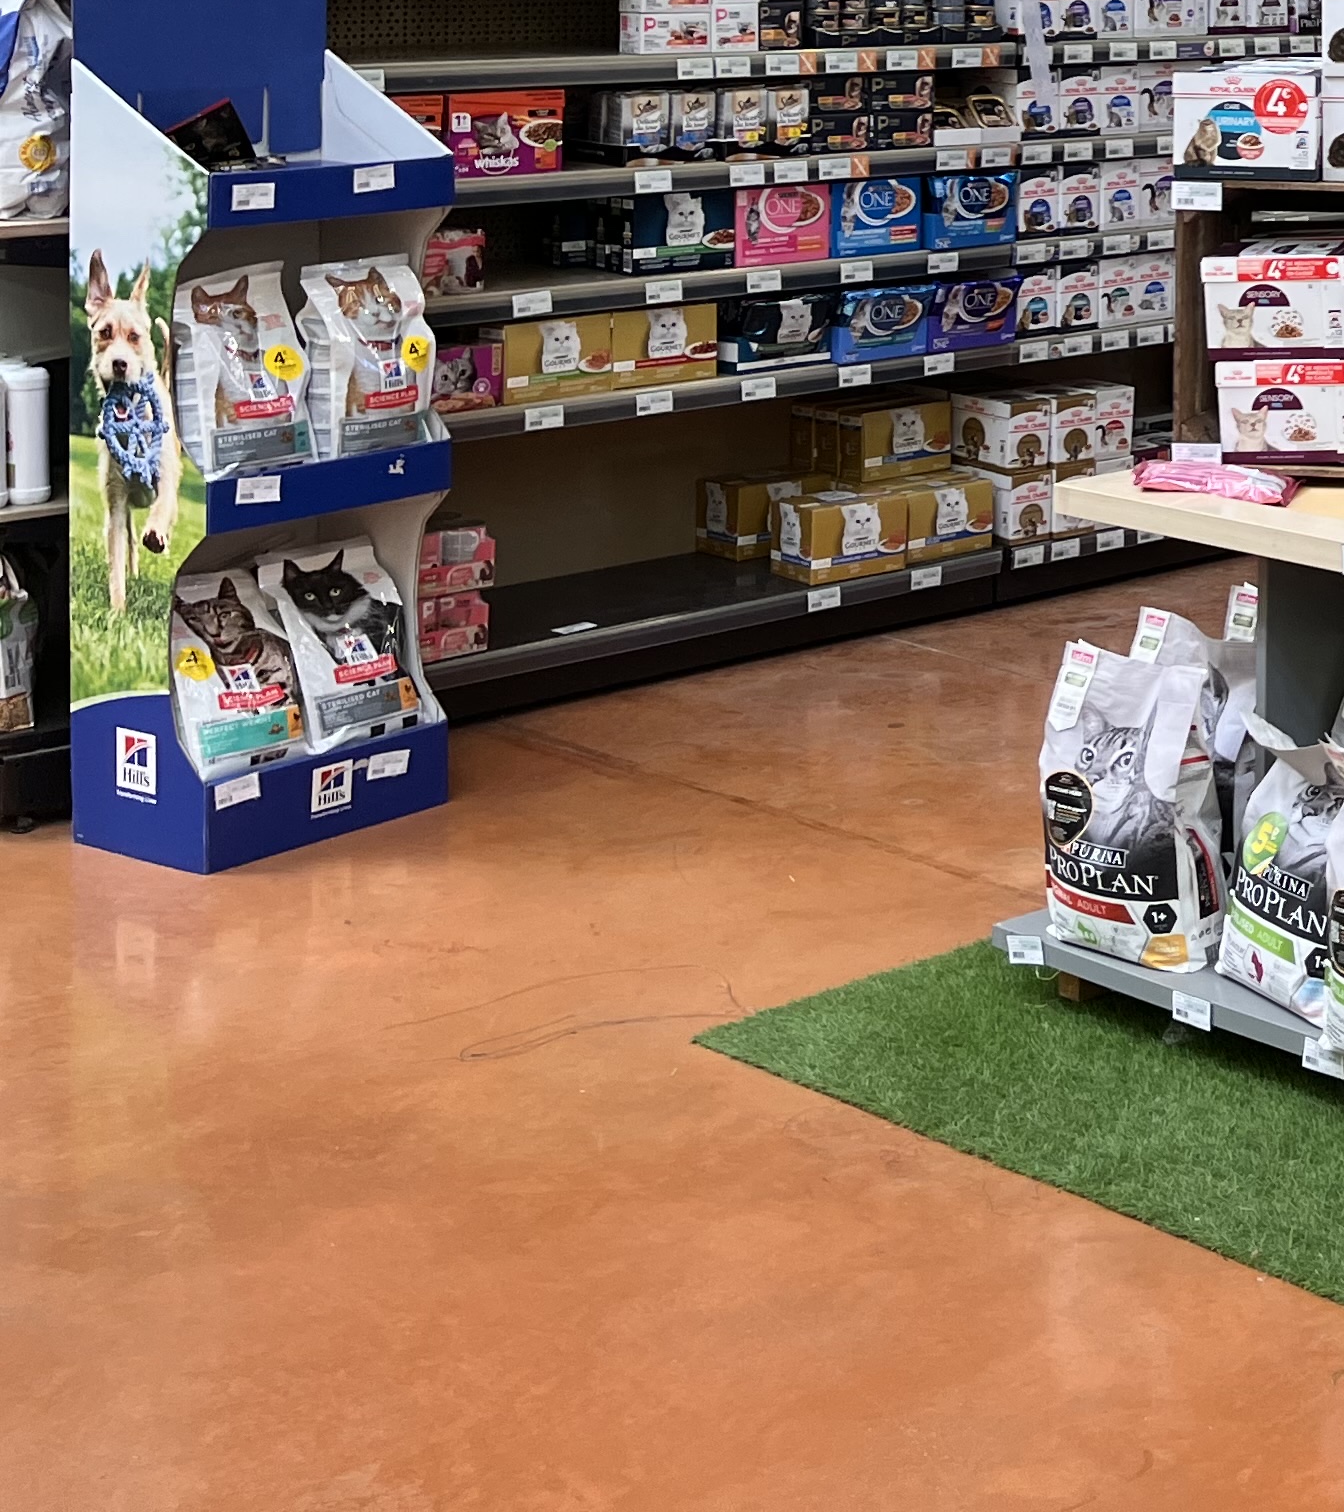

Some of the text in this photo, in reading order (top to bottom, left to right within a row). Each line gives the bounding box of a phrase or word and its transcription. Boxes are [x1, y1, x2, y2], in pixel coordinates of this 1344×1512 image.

[860, 190, 893, 208] ONE
[960, 186, 991, 203] ONE
[765, 196, 801, 216] ONE
[122, 765, 151, 788] Hill's
[317, 789, 346, 807] Hill's
[1070, 841, 1123, 866] PURINA
[1076, 898, 1108, 916] ADULT
[1151, 910, 1168, 924] 1+
